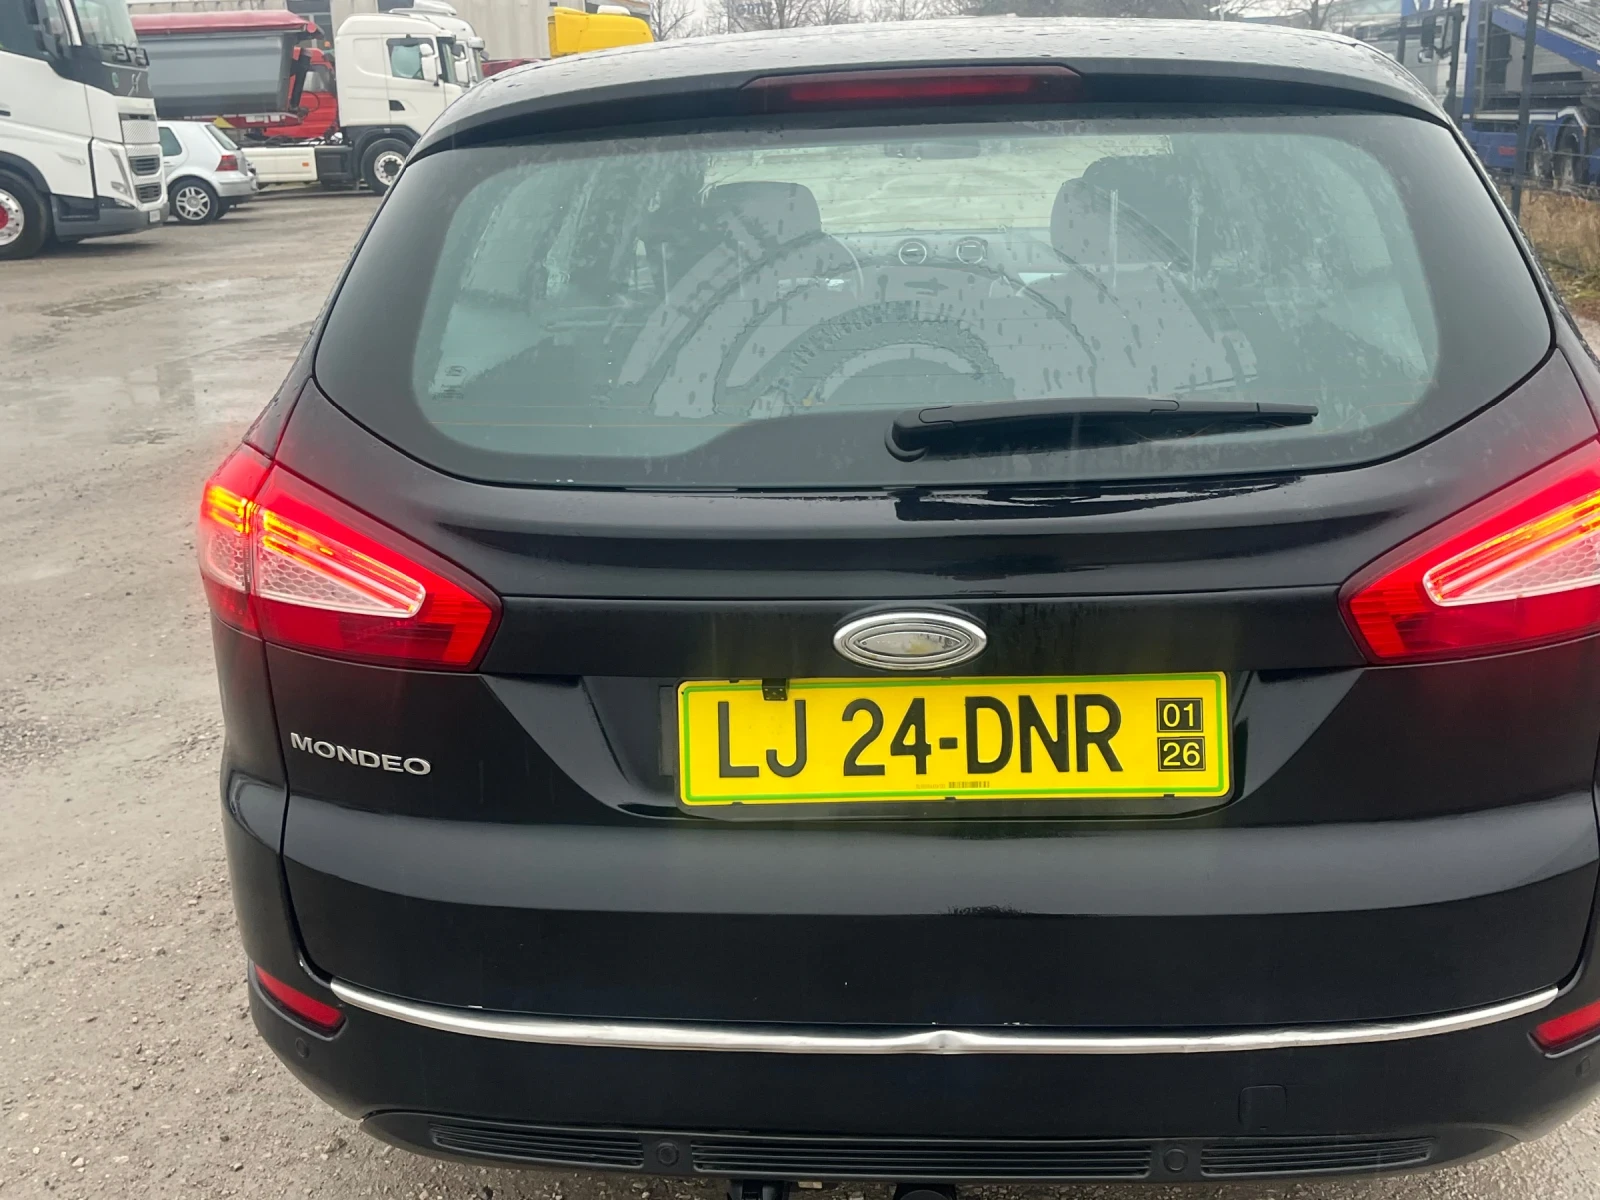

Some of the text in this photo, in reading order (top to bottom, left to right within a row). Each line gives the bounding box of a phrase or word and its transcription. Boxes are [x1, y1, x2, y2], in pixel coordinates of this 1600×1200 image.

[1163, 703, 1194, 727] 01
[718, 693, 1123, 778] LJ 24-DNR
[290, 732, 431, 775] MONDEO
[1163, 741, 1201, 767] 26
